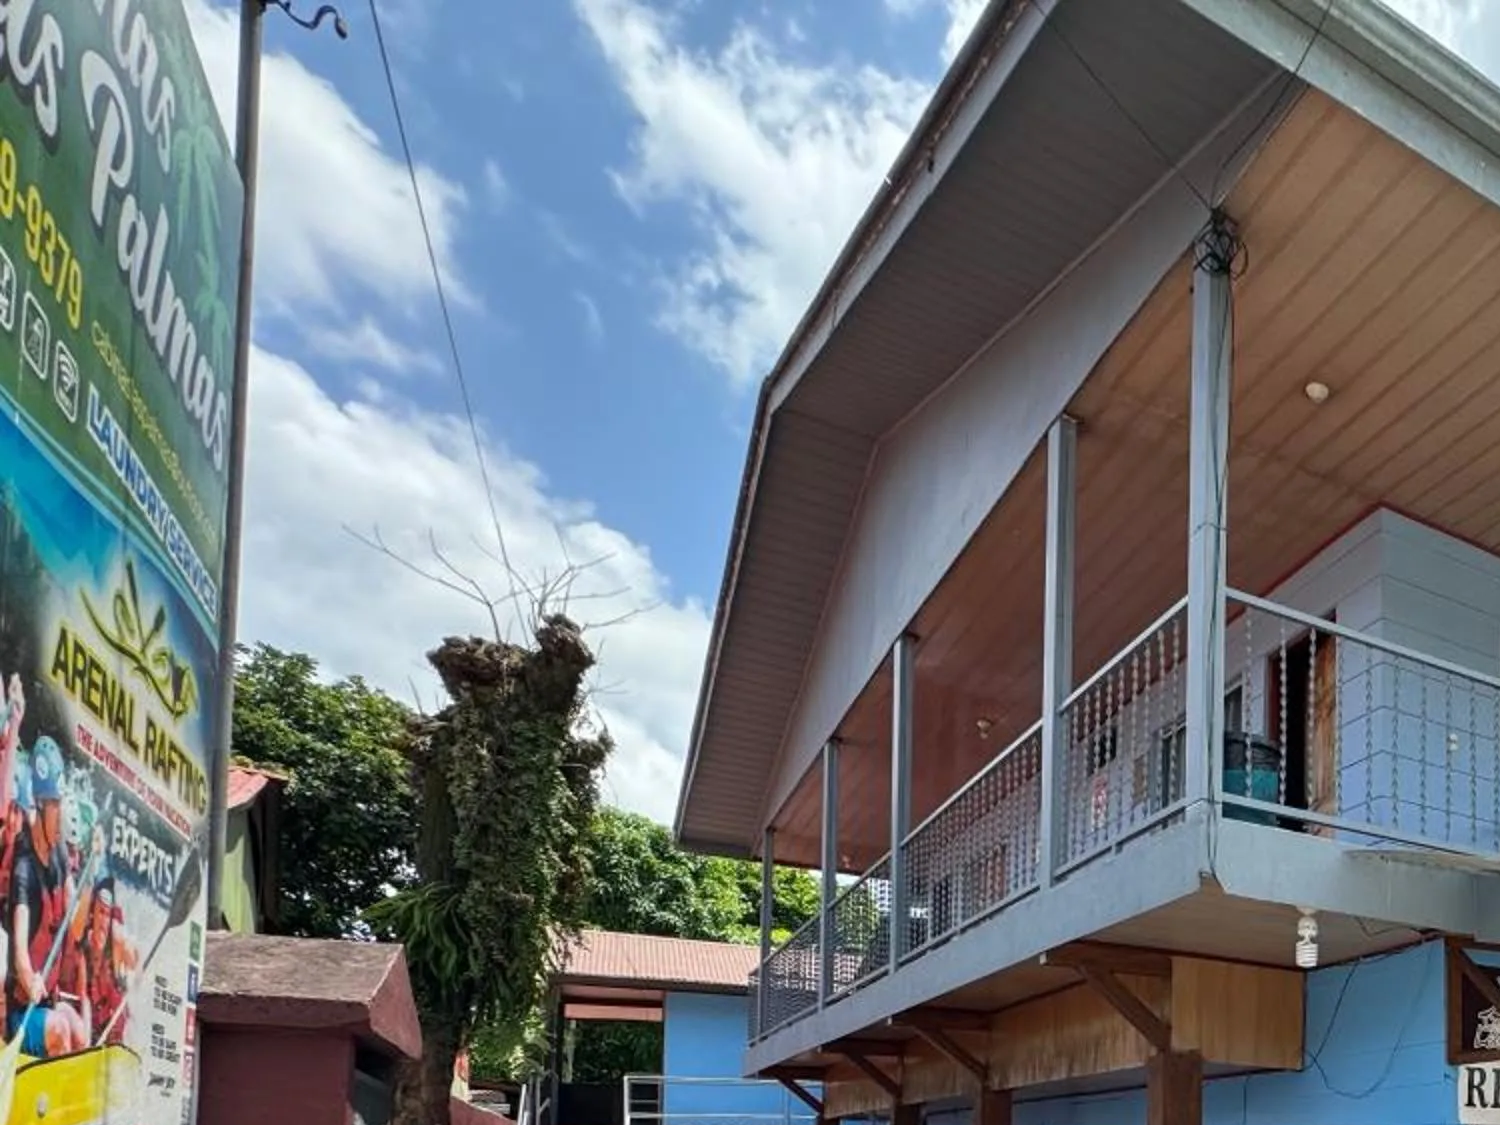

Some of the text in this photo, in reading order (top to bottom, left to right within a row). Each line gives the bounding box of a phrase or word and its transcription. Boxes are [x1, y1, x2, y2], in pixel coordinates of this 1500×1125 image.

[80, 49, 230, 471] Palmas
[87, 380, 167, 543] LAUNDRY
[51, 625, 207, 818] ARENAL RAFTING
[111, 814, 173, 896] EXPERTS
